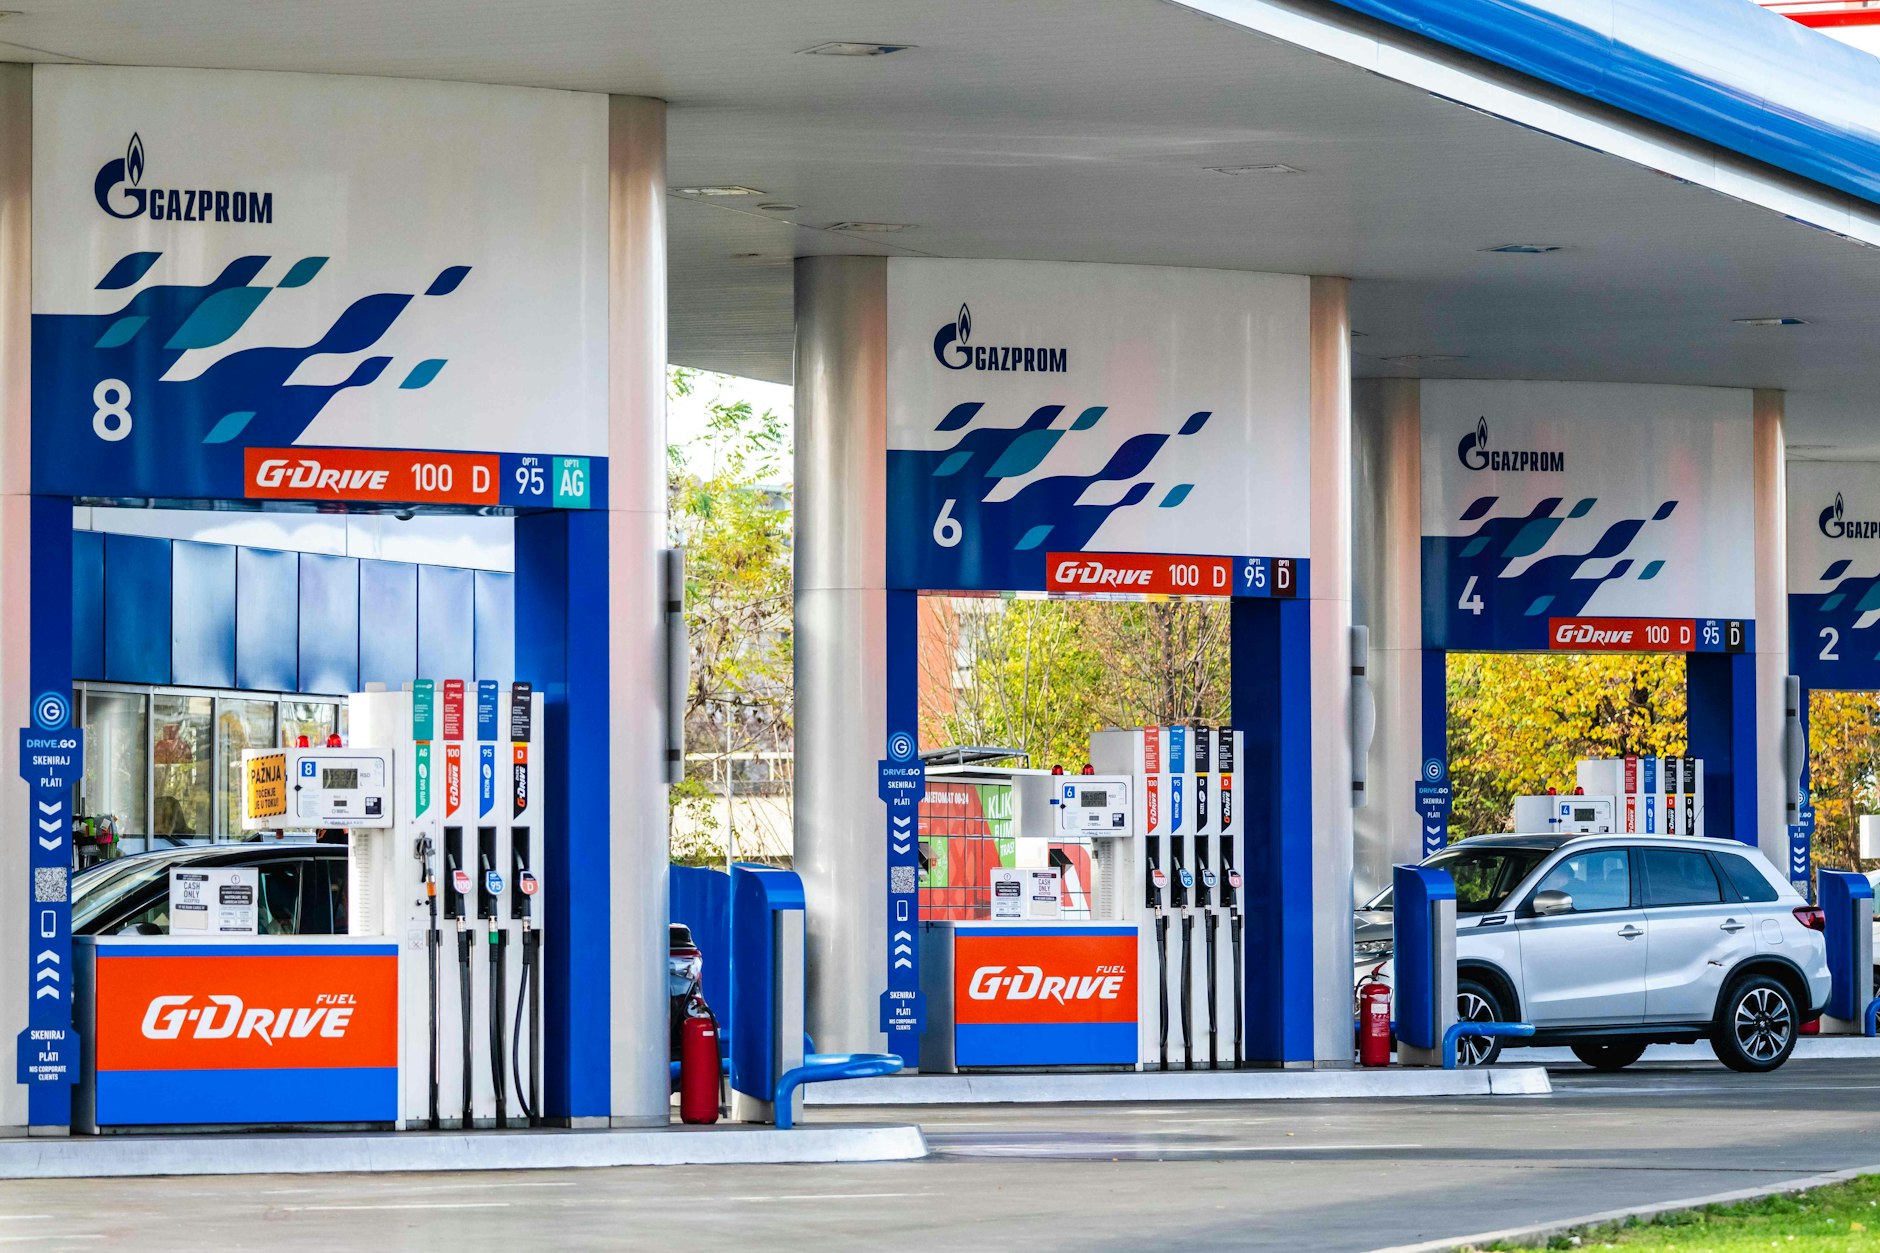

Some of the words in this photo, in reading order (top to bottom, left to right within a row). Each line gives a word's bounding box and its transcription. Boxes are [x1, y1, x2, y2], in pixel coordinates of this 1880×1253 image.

[150, 189, 272, 223] GAZPROM
[975, 347, 1067, 372] GAZPROM
[93, 379, 132, 441] 8
[522, 457, 538, 466] OPTI
[564, 459, 579, 468] OPTI
[1491, 451, 1564, 471] GAZPROM
[411, 464, 452, 491] 100
[473, 466, 490, 493] D
[516, 467, 544, 495] 95
[560, 469, 584, 496] AG
[933, 499, 962, 547] 6
[1846, 522, 1880, 538] GAZP
[1169, 564, 1199, 586] 100
[1213, 566, 1226, 587] D
[1244, 566, 1265, 587] 95
[1278, 567, 1289, 588] D
[1458, 576, 1484, 615] 4
[1645, 626, 1669, 643] 100
[1680, 627, 1690, 644] D
[1703, 627, 1719, 644] 95
[1731, 628, 1740, 645] D
[1819, 627, 1839, 660] 2
[27, 739, 76, 748] DRIVE.GO
[419, 749, 427, 757] AG
[447, 749, 459, 757] 100
[483, 749, 492, 757] 95
[33, 756, 70, 765] SKENIRAJ
[50, 767, 52, 776] I
[252, 763, 281, 783] PAŽNJA
[305, 763, 312, 775] 8
[41, 778, 62, 787] PLATI
[1067, 788, 1072, 797] 6
[261, 800, 264, 808] U
[1563, 806, 1568, 814] 4
[184, 882, 200, 890] CASH
[458, 881, 470, 890] 100
[491, 881, 501, 889] 95
[184, 890, 200, 898] ONLY
[316, 994, 357, 1004] FUEL
[30, 1030, 65, 1040] SKENIRAJ
[47, 1041, 50, 1051] I
[39, 1052, 58, 1061] PLATI
